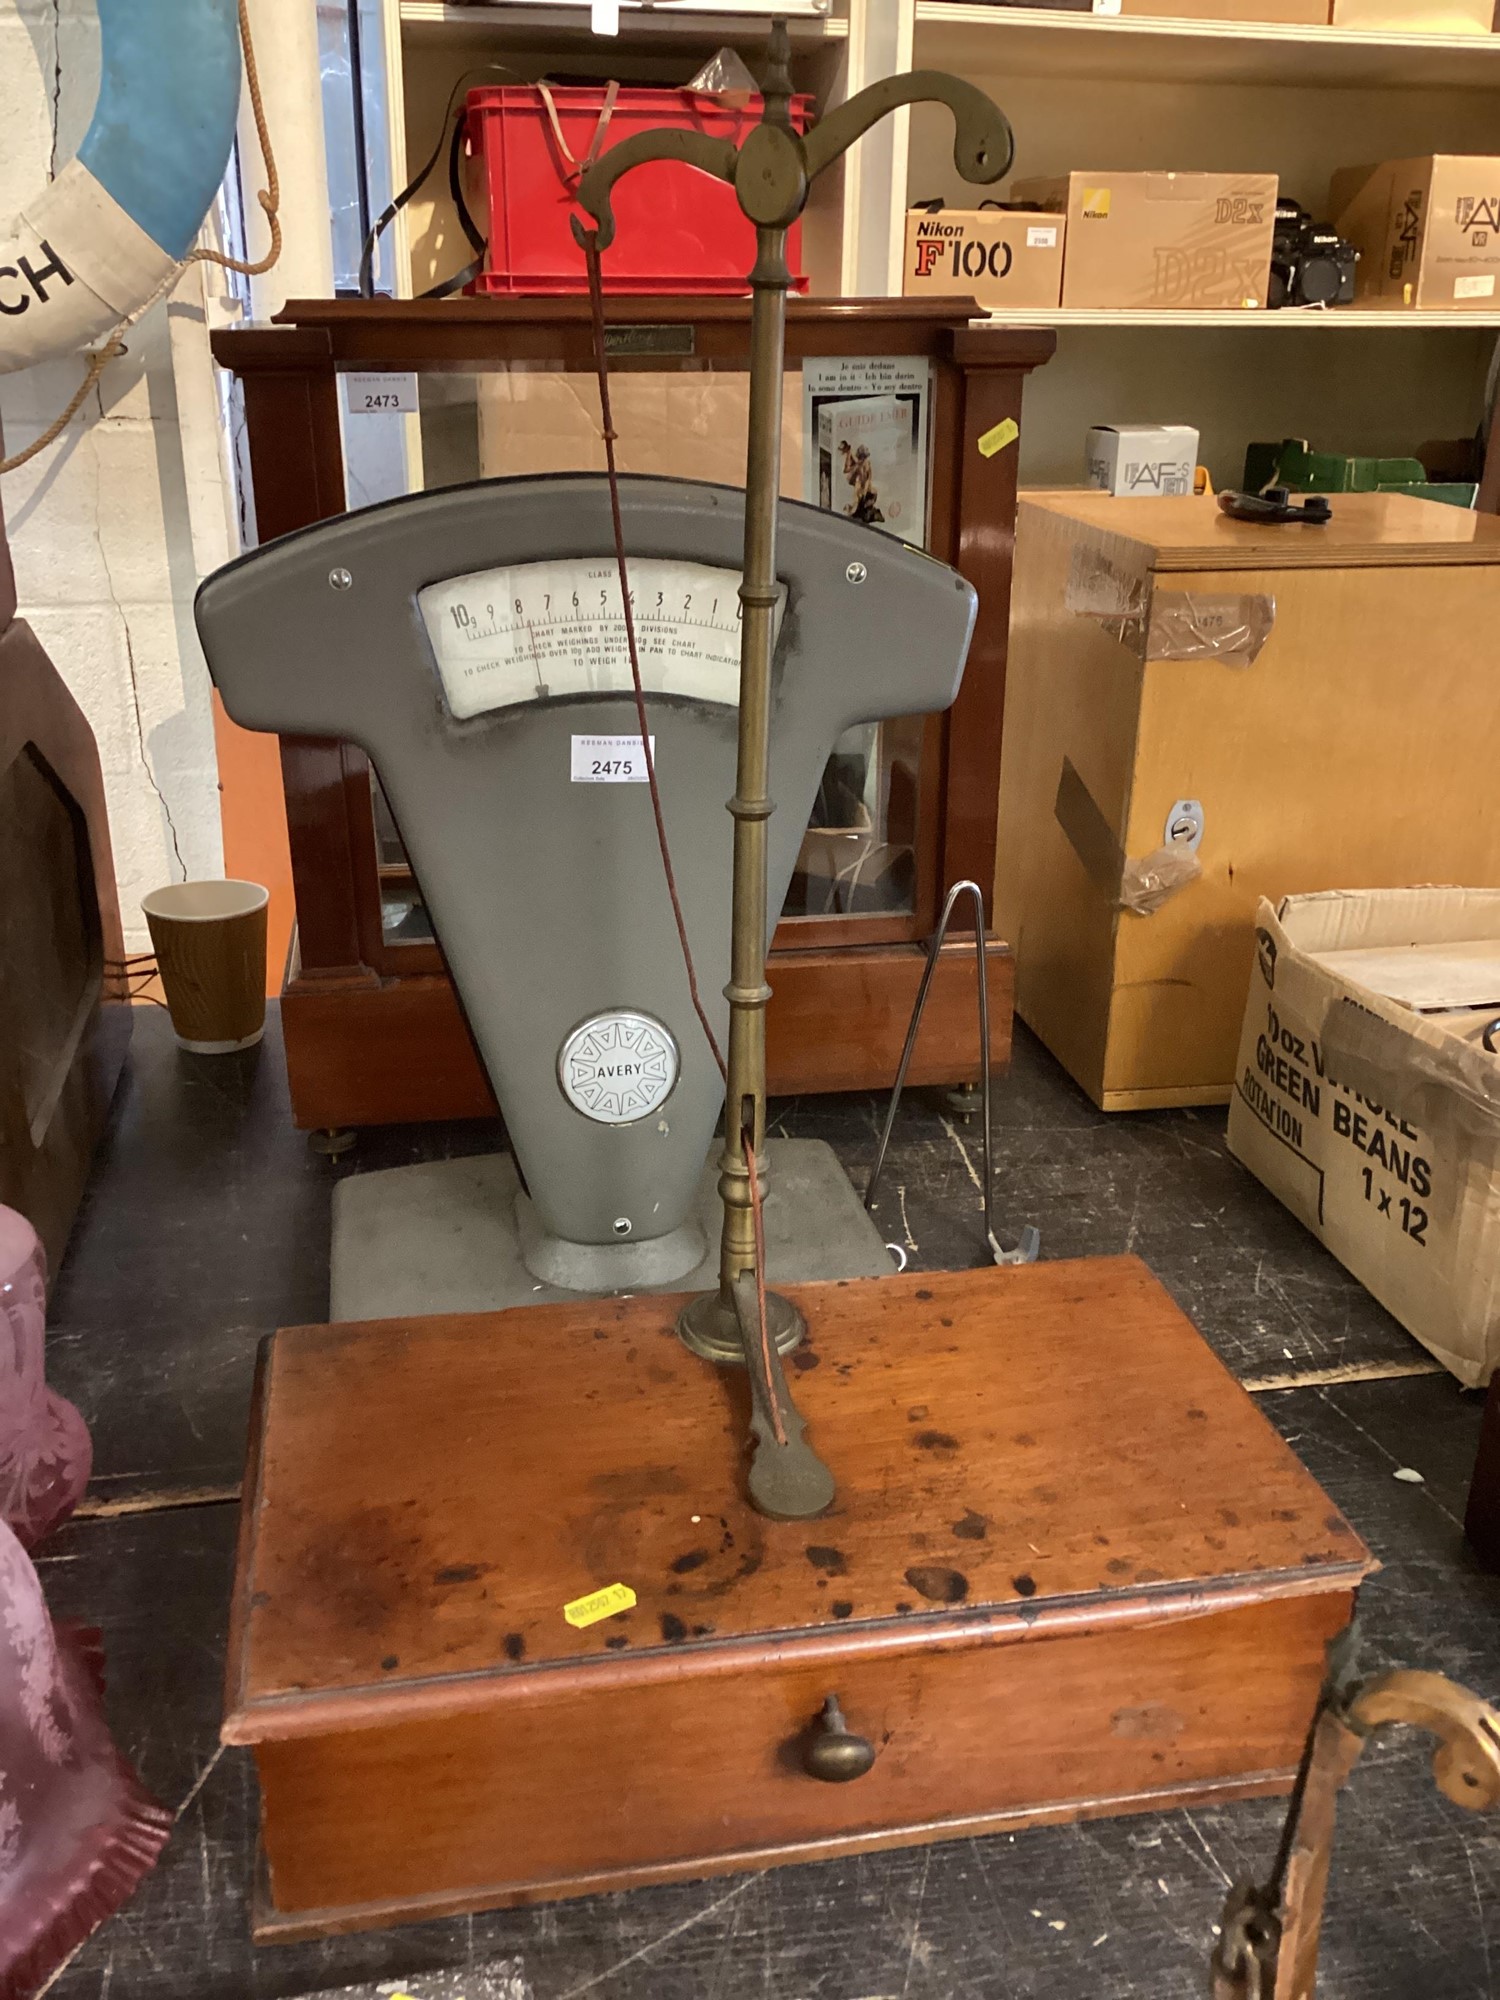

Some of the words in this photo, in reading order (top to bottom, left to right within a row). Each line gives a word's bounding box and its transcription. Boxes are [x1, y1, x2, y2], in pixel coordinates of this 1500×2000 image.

[1083, 210, 1109, 219] Nikon
[917, 221, 964, 237] Nikon
[1313, 235, 1339, 244] Nikon
[915, 240, 1012, 278] F100
[365, 395, 399, 408] 2473
[588, 571, 612, 579] CLASS
[487, 604, 494, 620] 9
[514, 598, 523, 614] 8
[544, 594, 551, 610] 7
[572, 591, 580, 607] 6
[600, 590, 608, 606] 5
[656, 592, 664, 607] 3
[683, 594, 692, 610] 2
[713, 598, 718, 614] 1
[561, 625, 593, 634] MARKED
[641, 625, 678, 634] DIVISIONS
[514, 647, 523, 655] TO
[528, 640, 553, 651] CHECK
[557, 637, 599, 647] WEIGHINGS
[653, 637, 667, 646] SEE
[672, 640, 696, 649] CHART
[464, 669, 473, 677] TO
[476, 662, 500, 673] CHECK
[504, 651, 546, 665] WEIGHINGS
[549, 648, 568, 658] OVER
[586, 646, 600, 654] ADD
[650, 646, 664, 654] PAN
[680, 649, 702, 659] CHART
[573, 658, 584, 666] TO
[589, 656, 617, 665] WEIGH
[592, 760, 632, 775] 2475
[597, 1063, 642, 1078] AVERY
[1257, 1033, 1320, 1118] GREEN
[1333, 1099, 1431, 1198] BEANS
[1362, 1167, 1372, 1201] 1
[1376, 1188, 1391, 1220] x
[1399, 1198, 1428, 1247] 12
